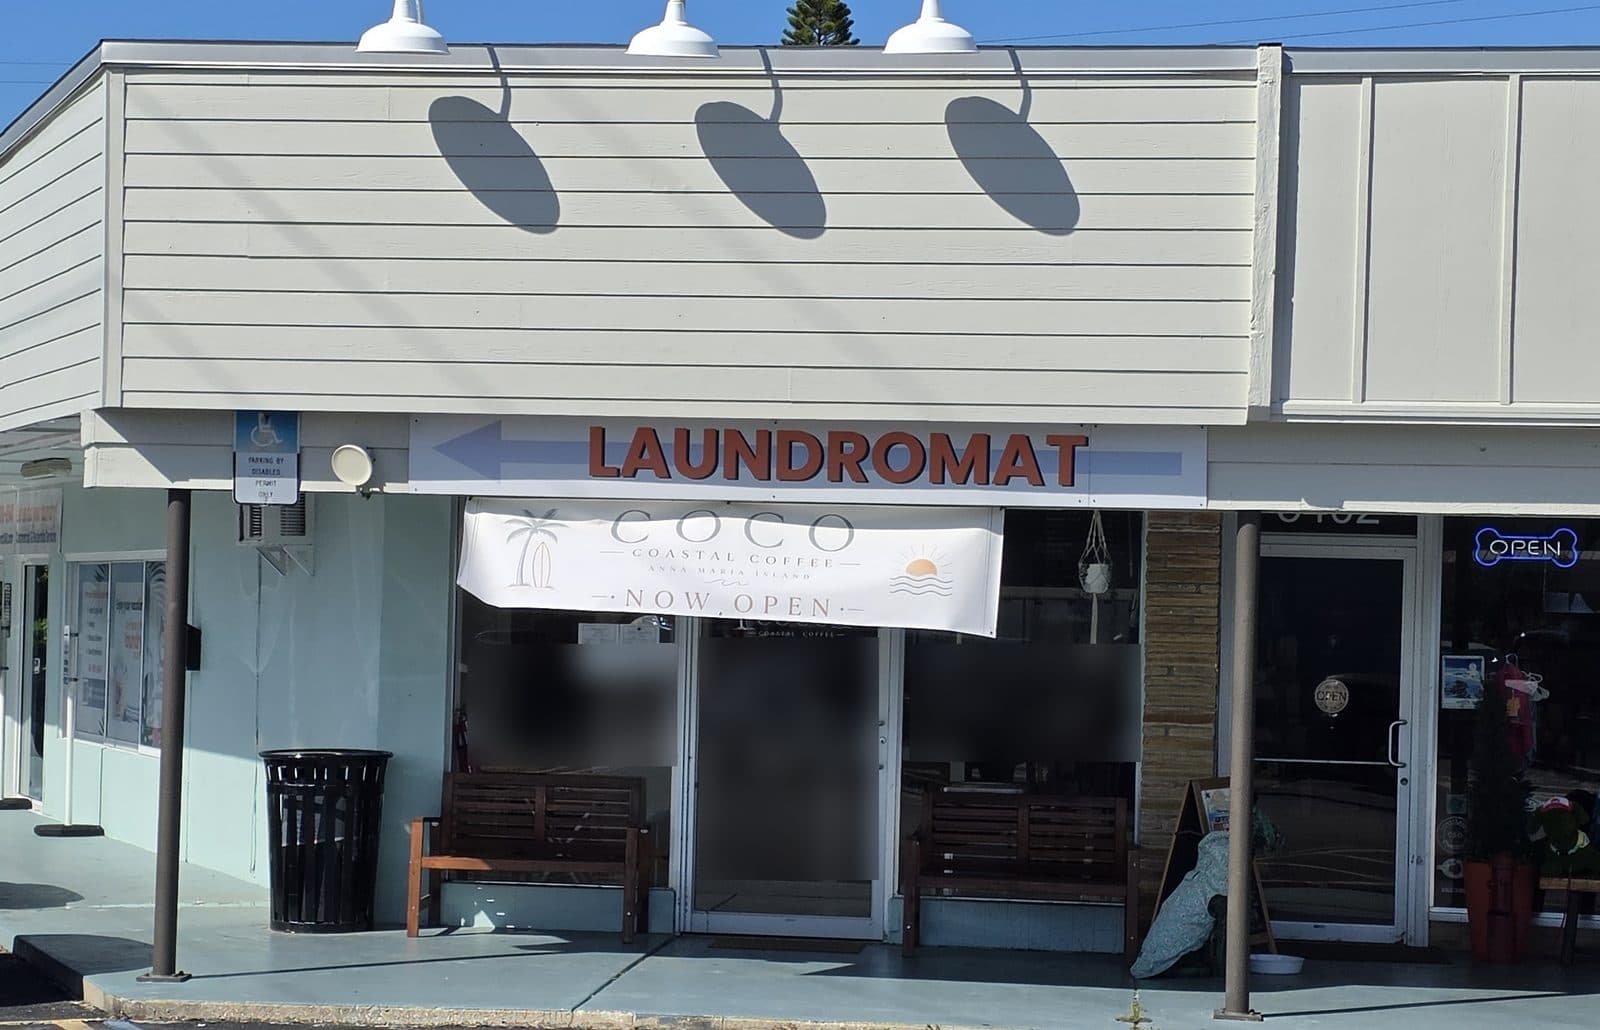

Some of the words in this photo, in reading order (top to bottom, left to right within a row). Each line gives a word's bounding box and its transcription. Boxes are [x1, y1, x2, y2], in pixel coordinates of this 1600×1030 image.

[248, 456, 273, 464] PARKING
[589, 427, 1089, 487] LAUNDROMAT
[610, 509, 855, 552] COCO
[1489, 539, 1561, 557] OPEN
[632, 548, 735, 562] COASTAL
[749, 554, 834, 568] COFFEE
[648, 565, 687, 574] ANNA
[698, 567, 745, 576] MARIA
[755, 570, 811, 580] ISLAND
[626, 588, 711, 611] NOW
[734, 594, 830, 617] OPEN
[1317, 691, 1347, 701] OPEN
